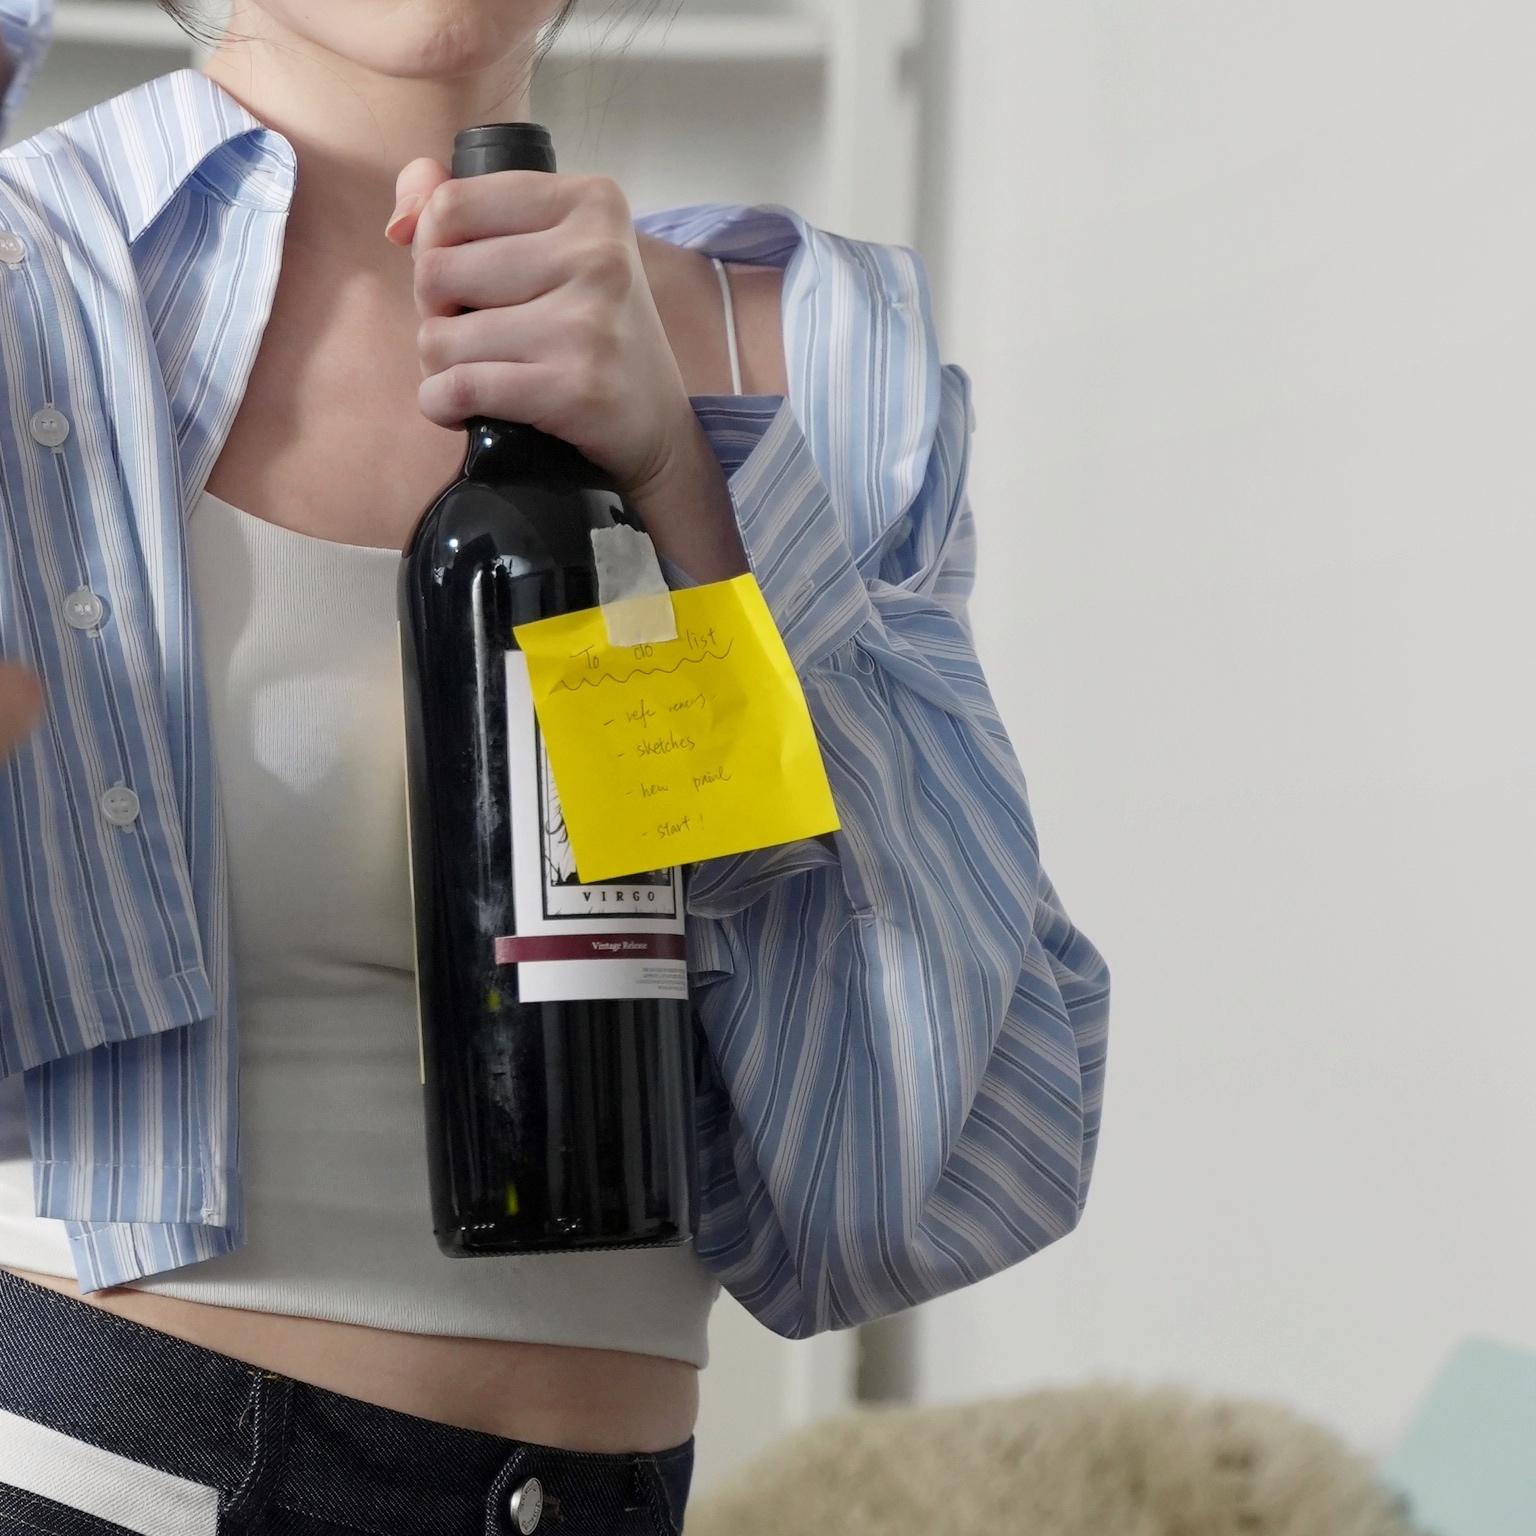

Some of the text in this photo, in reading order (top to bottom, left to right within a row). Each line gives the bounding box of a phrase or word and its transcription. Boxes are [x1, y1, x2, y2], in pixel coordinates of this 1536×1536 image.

[569, 628, 717, 670] To do list
[636, 729, 696, 758] sketches
[582, 891, 655, 902] VIRGO
[591, 941, 622, 952] Vintage
